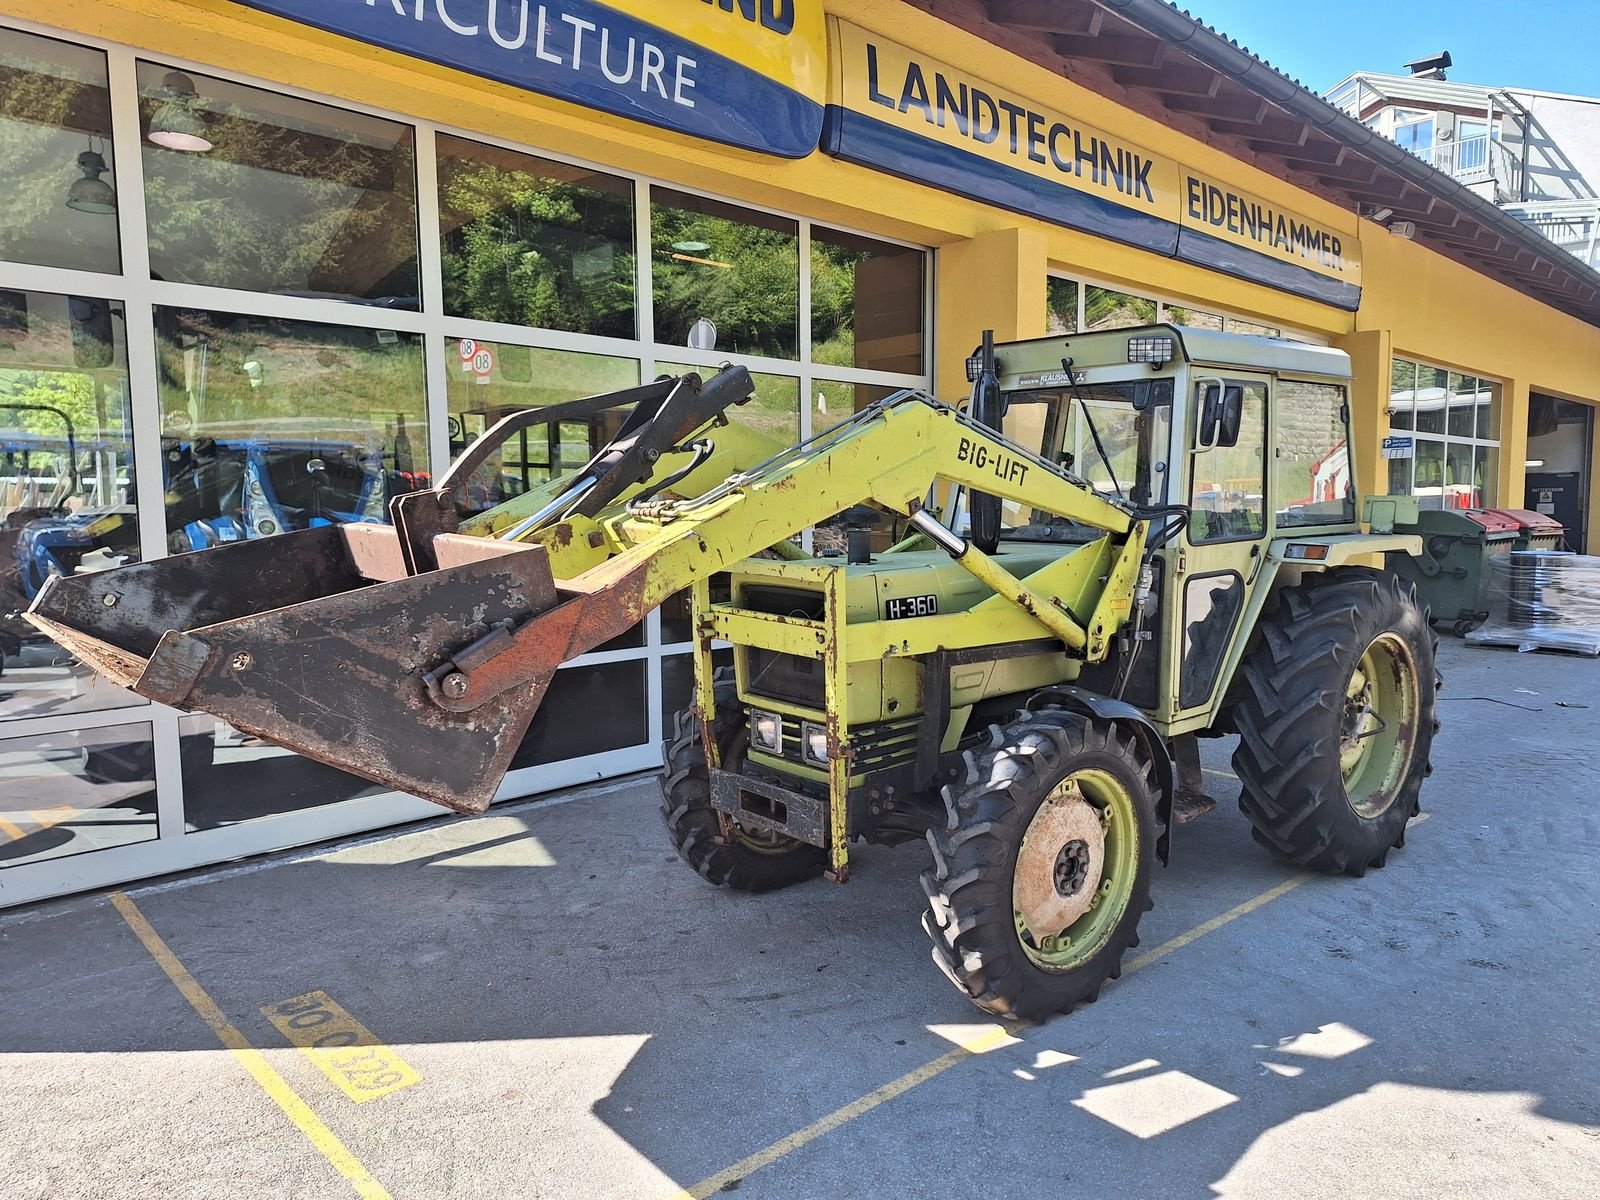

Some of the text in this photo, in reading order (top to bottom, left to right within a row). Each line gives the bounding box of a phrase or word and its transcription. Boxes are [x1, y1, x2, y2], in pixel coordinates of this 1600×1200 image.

[867, 43, 1343, 271] LANDTECHNIK EIDENHAMMER
[957, 437, 1029, 487] BIG-LIFT
[1384, 439, 1392, 448] P
[889, 595, 937, 619] H-360
